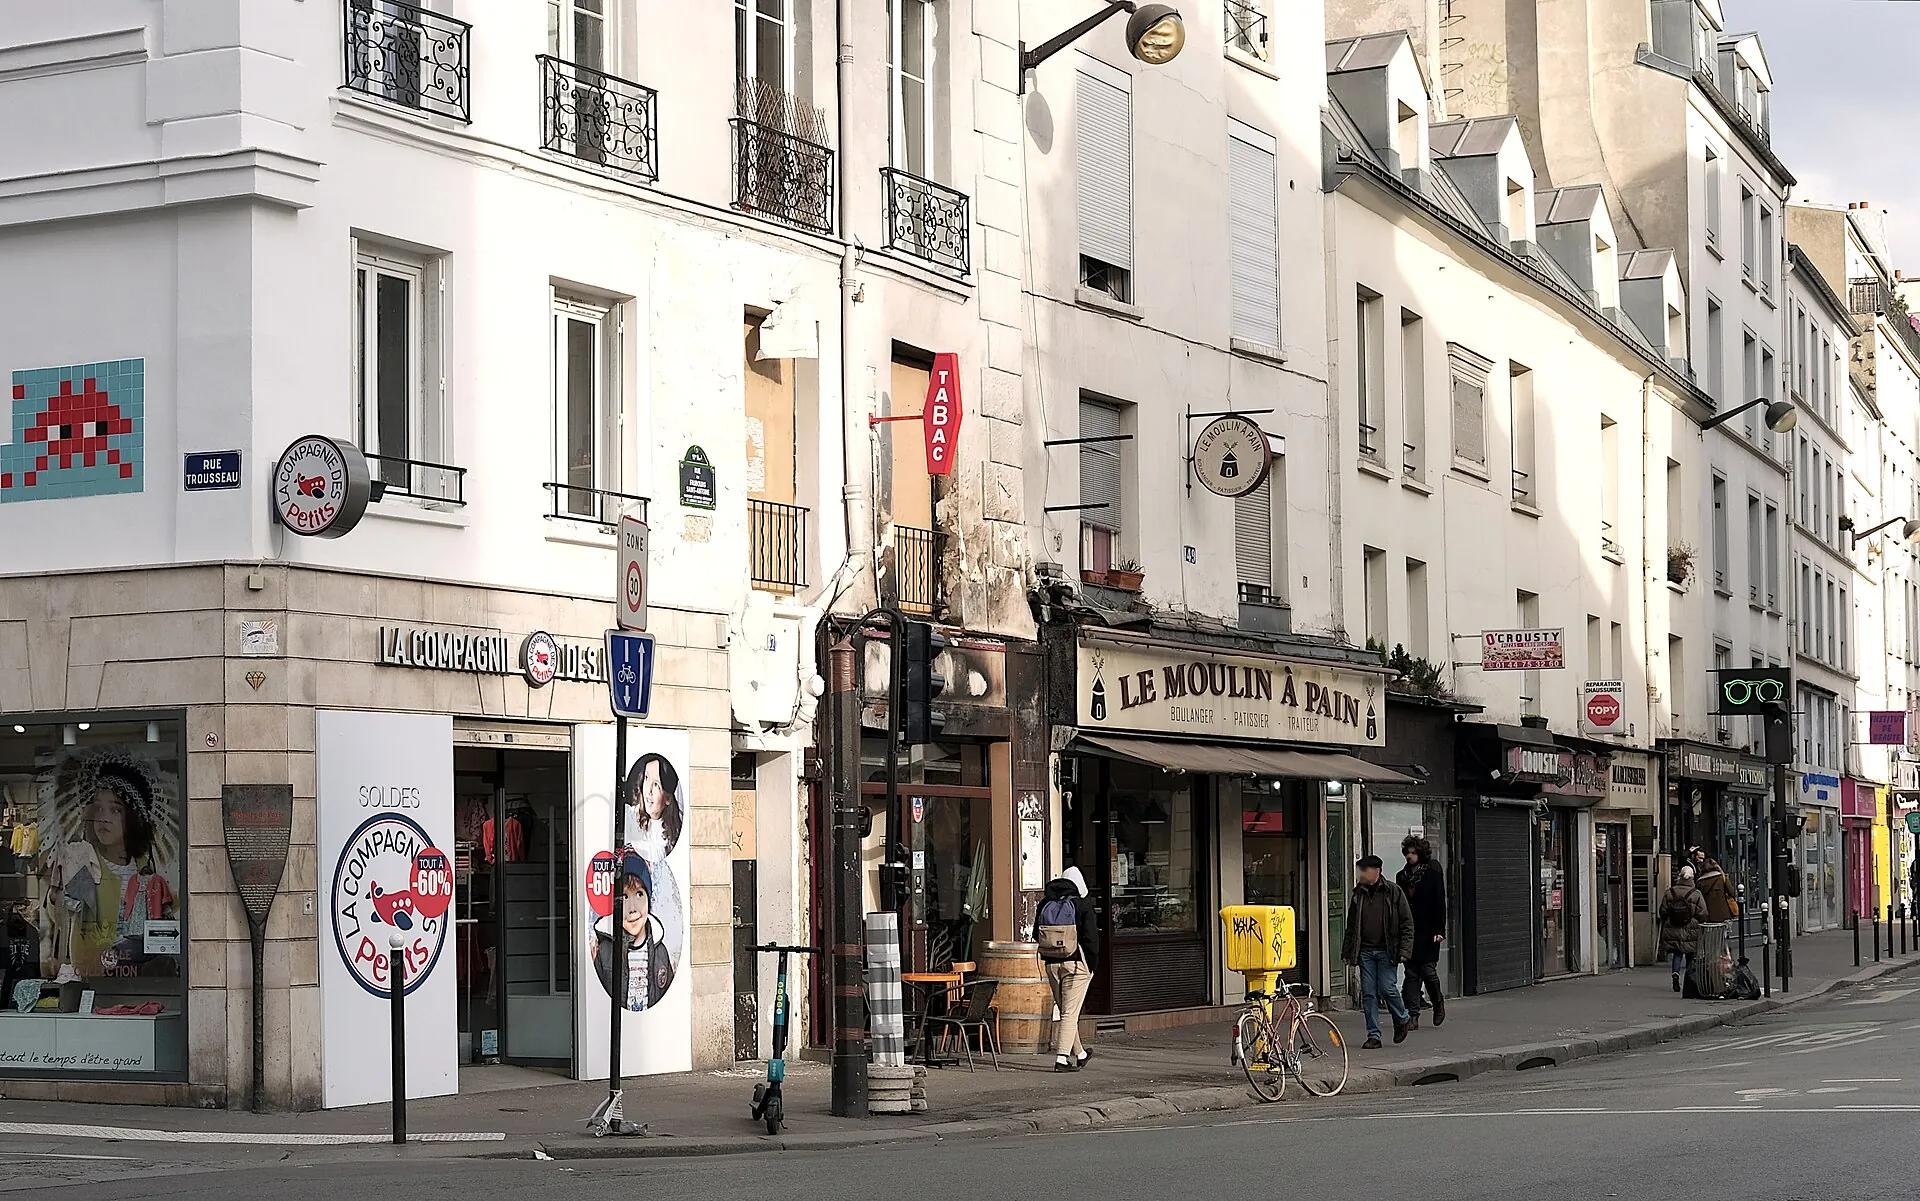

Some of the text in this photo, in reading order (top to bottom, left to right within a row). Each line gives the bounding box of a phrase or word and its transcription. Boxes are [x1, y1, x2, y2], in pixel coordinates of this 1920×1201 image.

[932, 370, 949, 462] TABAC
[1199, 439, 1212, 453] LE
[1207, 420, 1241, 442] MOULIN
[1245, 430, 1262, 452] PAIN
[202, 458, 222, 471] RUE
[278, 443, 343, 506] LA COMPAGNIE DES
[186, 471, 239, 485] TROUSSEAU
[626, 532, 644, 552] ZONE
[629, 576, 639, 597] 30
[379, 626, 411, 664] LA
[1486, 632, 1560, 646] O'CROUSTY
[1119, 662, 1361, 728] LE MOULIN À PAIN
[1170, 706, 1319, 733] BOULANGER PATISSIER TRAITEUR
[1589, 706, 1618, 715] TOPY
[359, 785, 421, 809] SOLDES
[418, 855, 445, 869] TOUT À
[593, 861, 610, 871] TOUT
[341, 828, 421, 940] LA COMPAGN
[412, 869, 451, 896] -60%
[355, 935, 429, 983] Pets
[0, 1051, 143, 1070] tout le temps d'être grand
